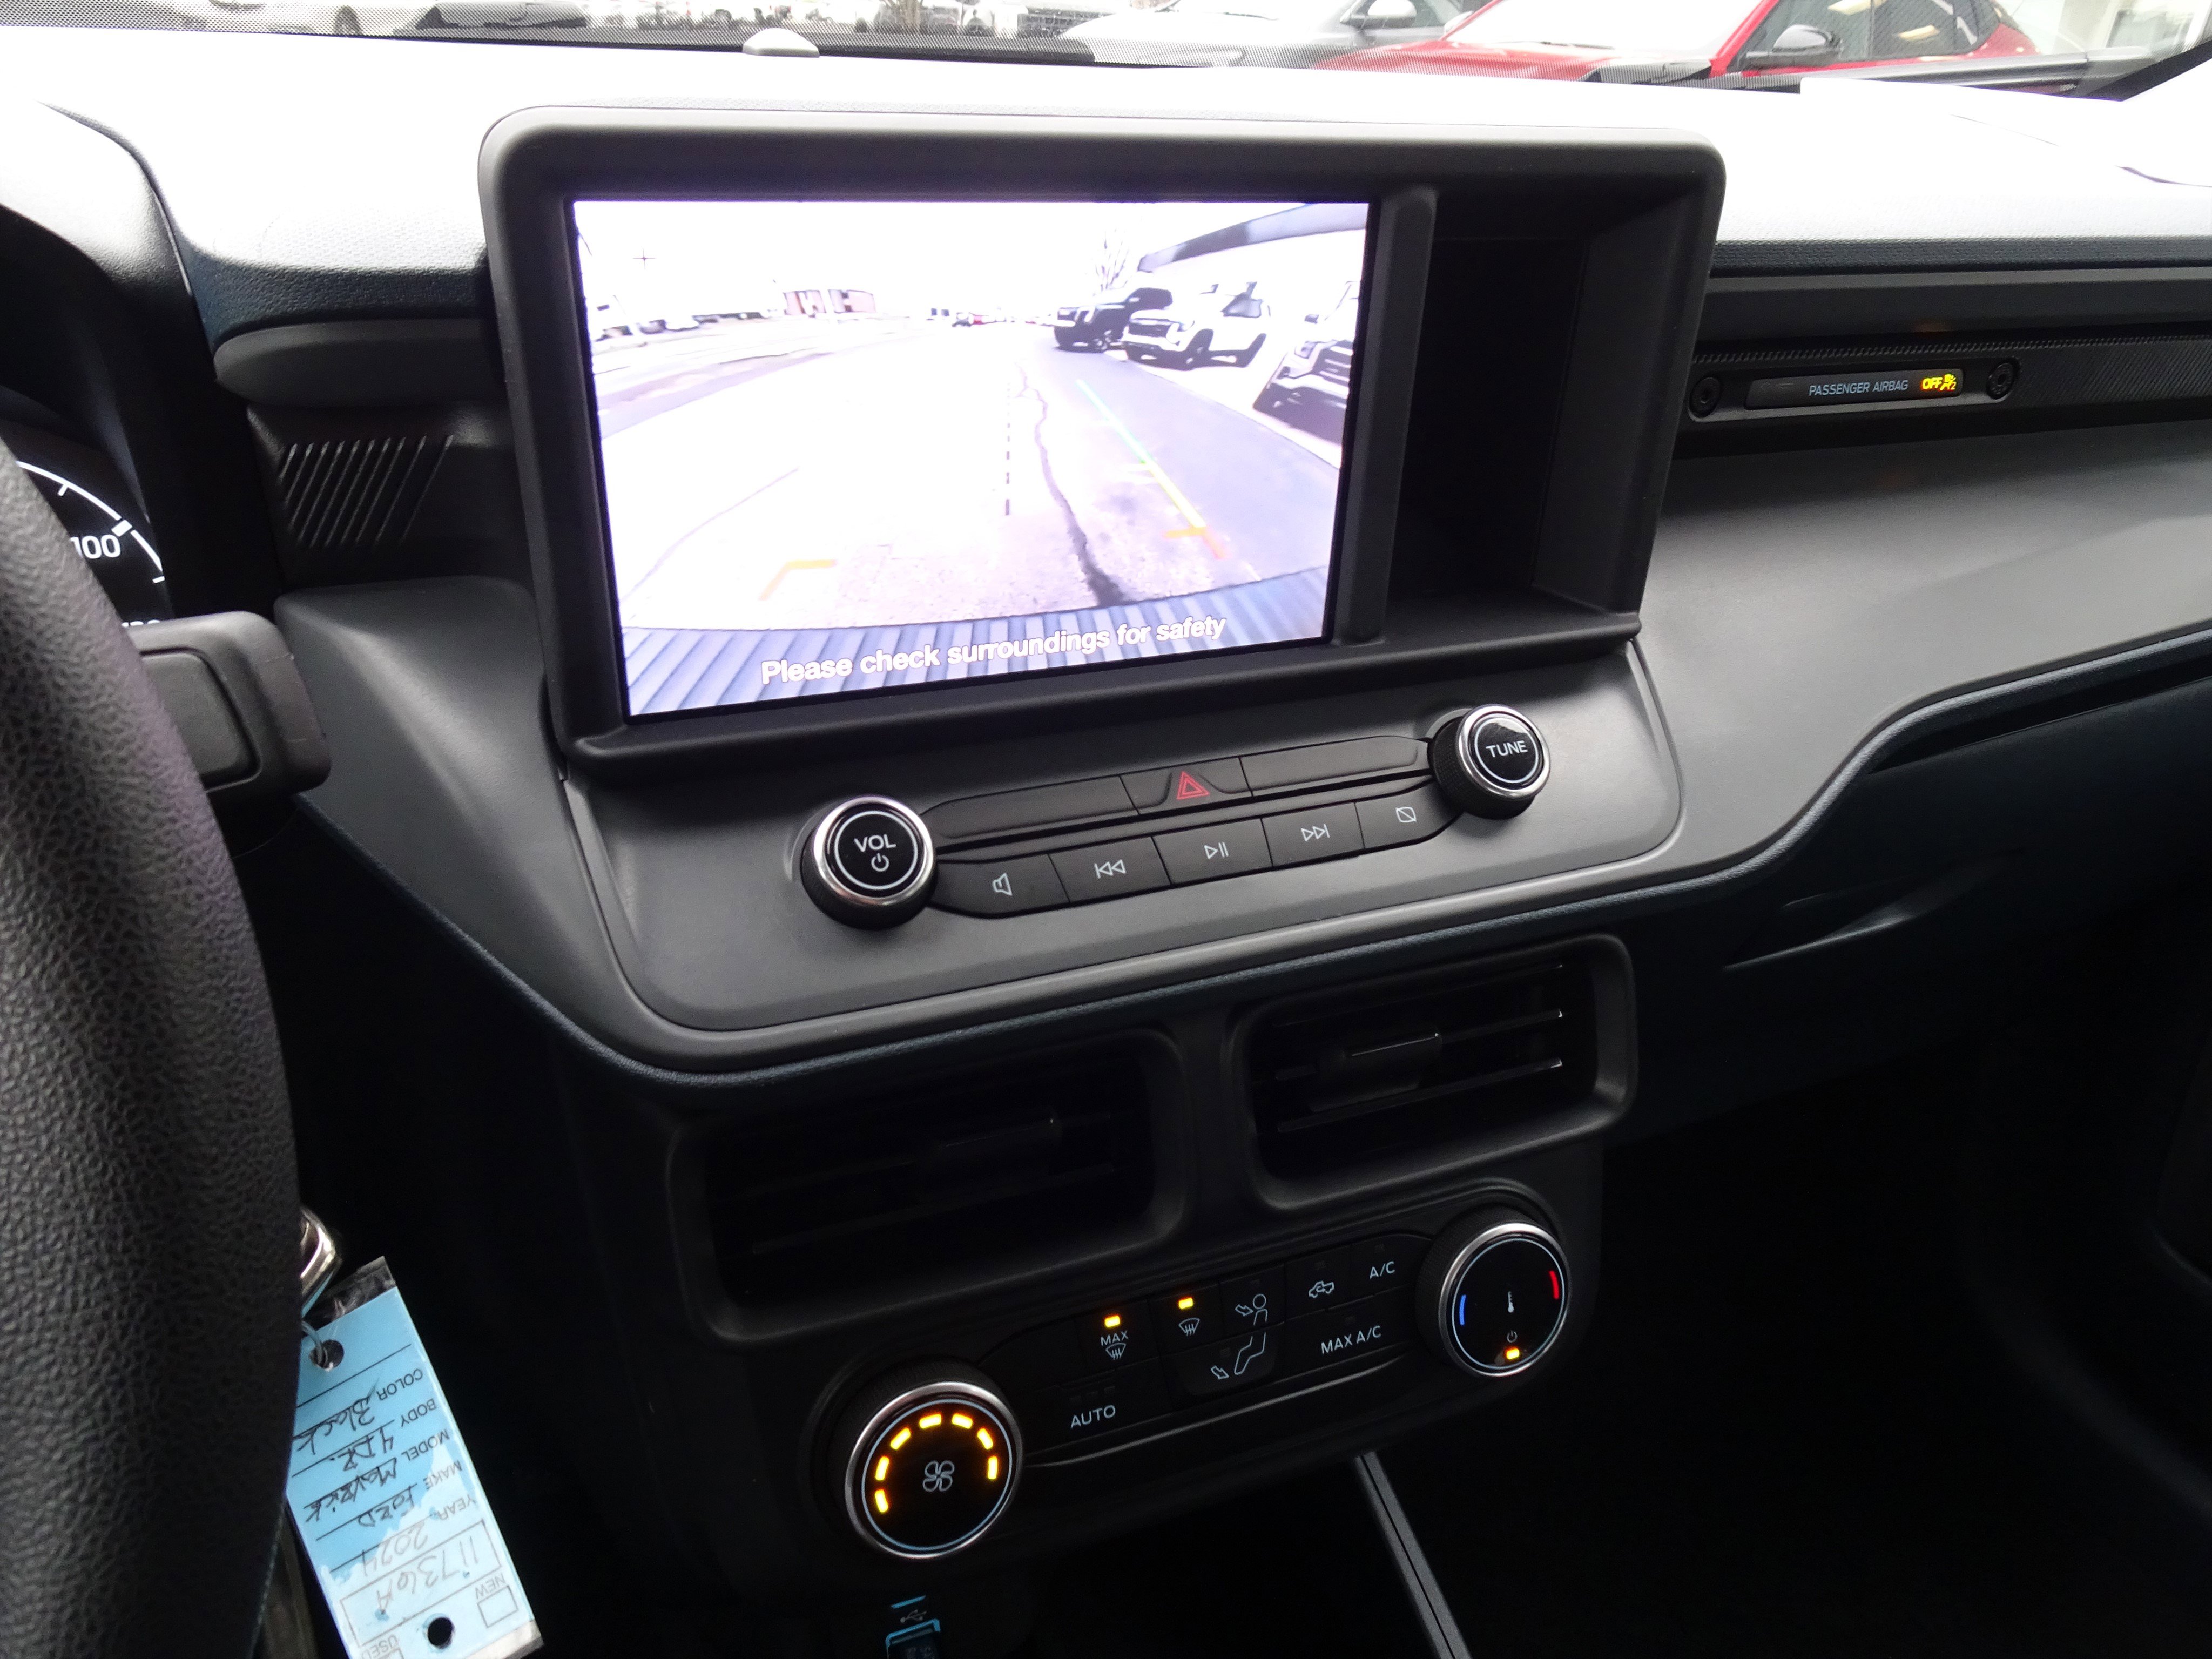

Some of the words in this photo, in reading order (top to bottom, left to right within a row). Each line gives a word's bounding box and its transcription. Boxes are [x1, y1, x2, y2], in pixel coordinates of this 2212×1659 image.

[1809, 382, 1870, 396] PASSENGER
[1873, 380, 1909, 392] AIRBAG
[1922, 377, 1943, 390] OFF
[761, 657, 853, 685] Please
[860, 645, 940, 673] check
[947, 624, 1111, 666] surroundings
[1116, 622, 1151, 646] for
[1156, 615, 1227, 642] safety
[1486, 740, 1528, 758] TUNE
[853, 834, 896, 853] VOL
[1369, 1261, 1395, 1279] A/C
[1100, 1330, 1129, 1346] MAX
[1321, 1334, 1354, 1354] MAX
[1355, 1325, 1382, 1344] A/C
[376, 1368, 423, 1401] COLOR
[297, 1382, 378, 1455] Black
[400, 1398, 438, 1427] BODY
[1070, 1405, 1116, 1429] AUTO
[401, 1428, 450, 1462] MODEL
[423, 1460, 462, 1491] MAKE
[432, 1494, 476, 1521] YEAR
[362, 1522, 428, 1577] 2024
[475, 1574, 507, 1600] NEW
